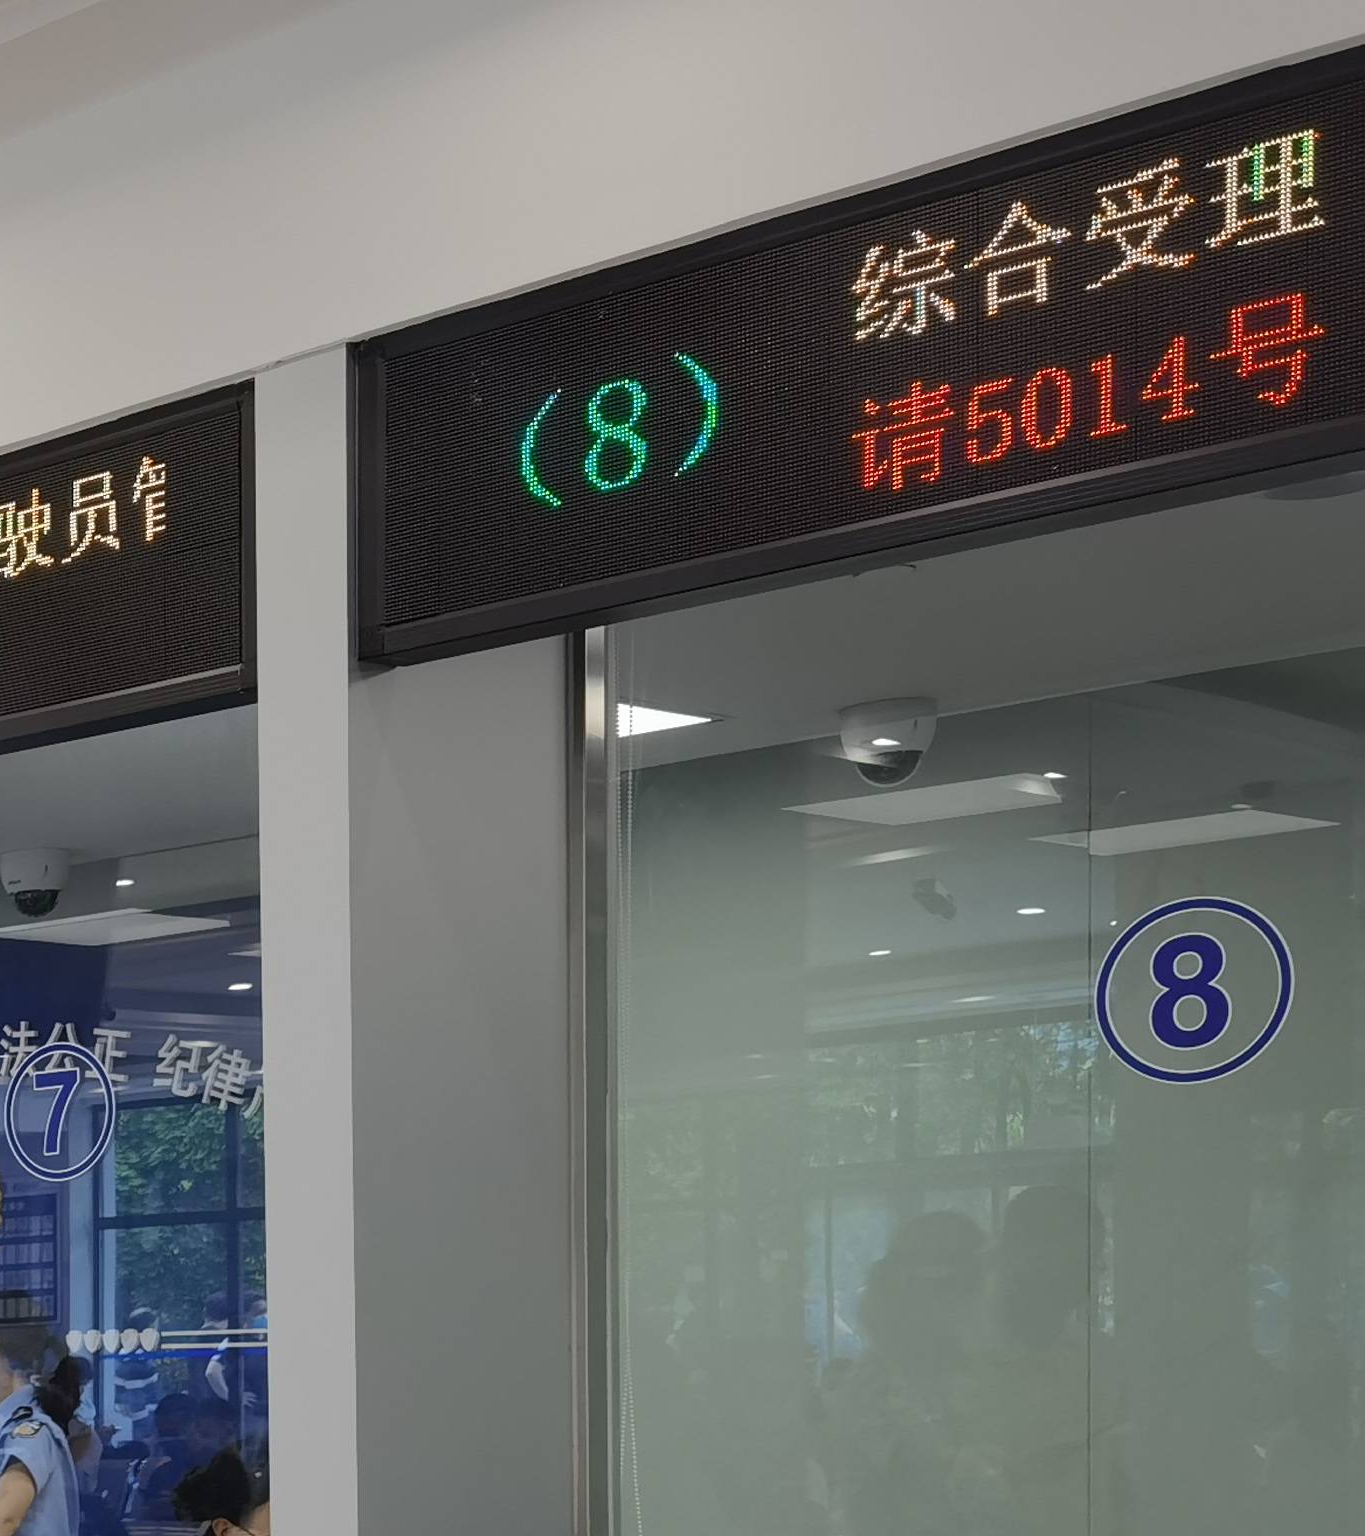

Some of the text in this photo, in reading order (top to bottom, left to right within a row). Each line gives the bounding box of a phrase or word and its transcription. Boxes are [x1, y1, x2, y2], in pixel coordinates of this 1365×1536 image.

[852, 129, 1324, 340] 综合受理
[521, 352, 719, 506] (8)
[852, 293, 1324, 491] 请5014号
[1150, 932, 1232, 1050] 8
[33, 1067, 80, 1156] 7
[153, 1033, 263, 1118] 纪律
